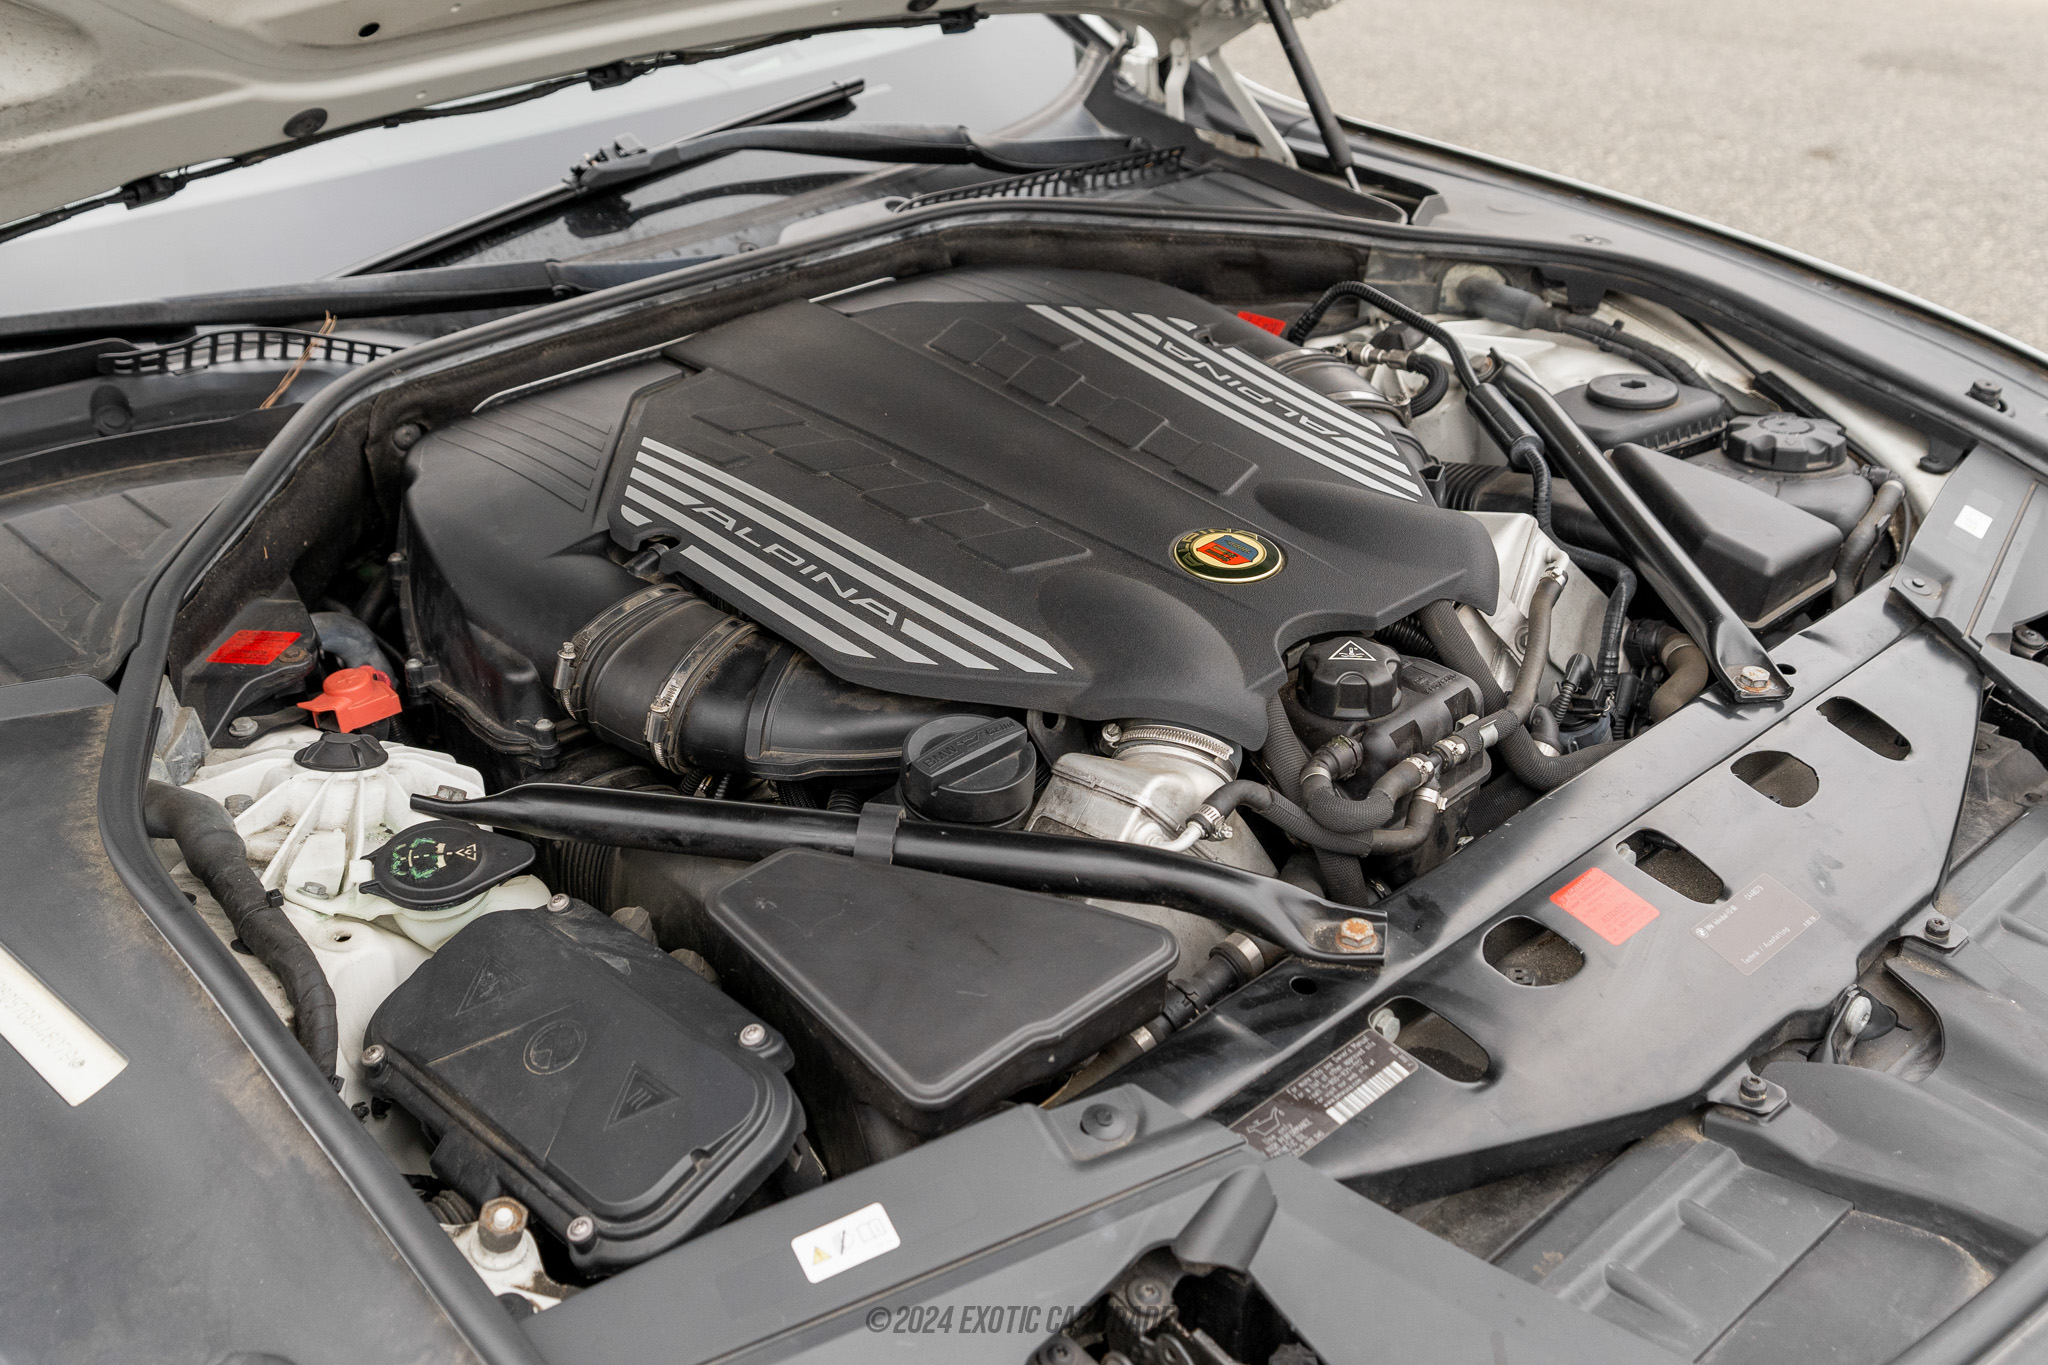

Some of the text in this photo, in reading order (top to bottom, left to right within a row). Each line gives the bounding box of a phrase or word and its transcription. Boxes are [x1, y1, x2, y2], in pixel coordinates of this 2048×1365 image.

[1163, 341, 1340, 435] ALPINA
[692, 507, 897, 626] ALPINA
[1177, 527, 1258, 567] ALPINA
[923, 745, 957, 768] BMW
